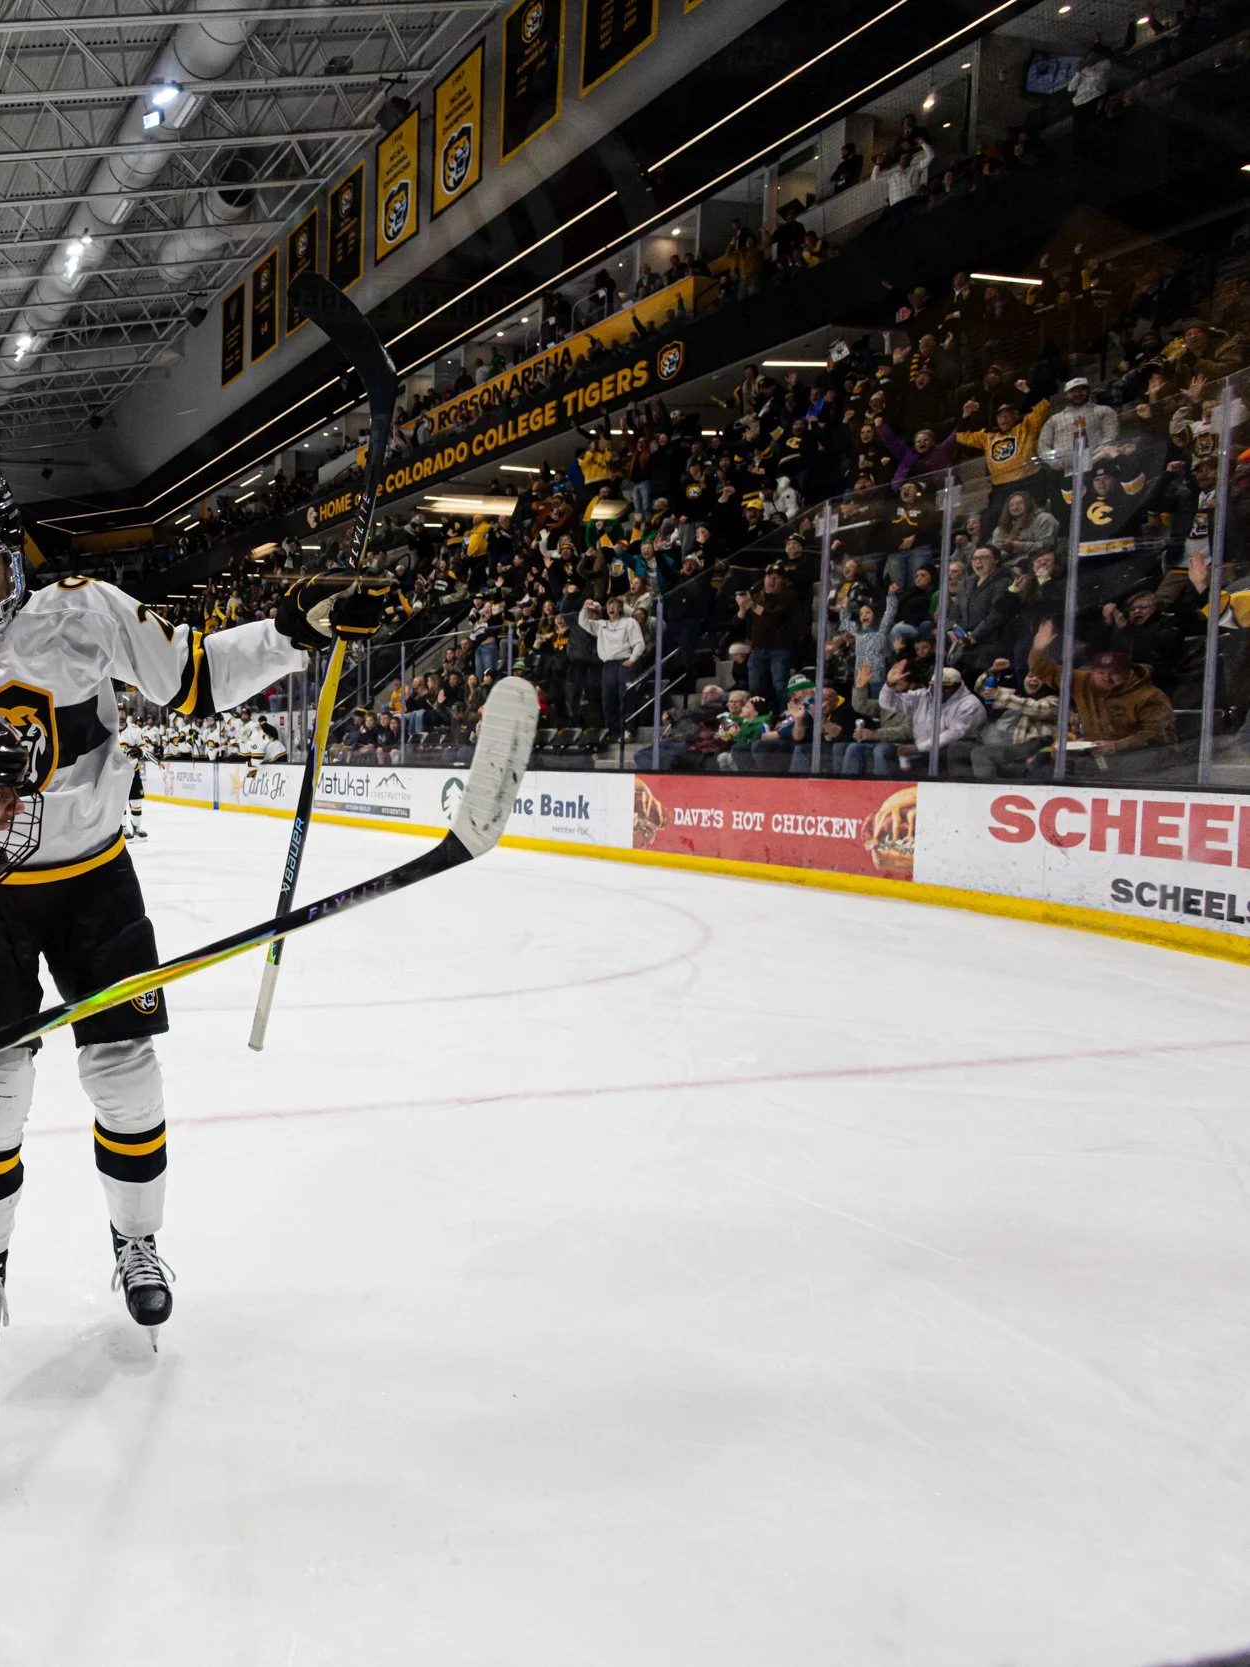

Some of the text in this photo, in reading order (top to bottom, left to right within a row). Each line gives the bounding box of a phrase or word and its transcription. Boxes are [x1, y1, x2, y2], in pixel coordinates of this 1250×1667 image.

[319, 492, 352, 522] HOME
[385, 441, 469, 494] COLORADO
[472, 400, 558, 456] COLLEGE
[563, 359, 649, 418] TIGERS
[243, 771, 286, 799] Carl's Jr.
[370, 791, 412, 800] CONSTRUCTION
[381, 807, 408, 816] RESIDENTIAL
[540, 794, 590, 819] Bank
[674, 807, 858, 839] DAVE'S HOT CHICKEN
[284, 817, 305, 883] BAUER
[988, 794, 1250, 869] SCHEE
[307, 875, 393, 920] FLYLITE
[1110, 878, 1250, 925] SCHEEL
